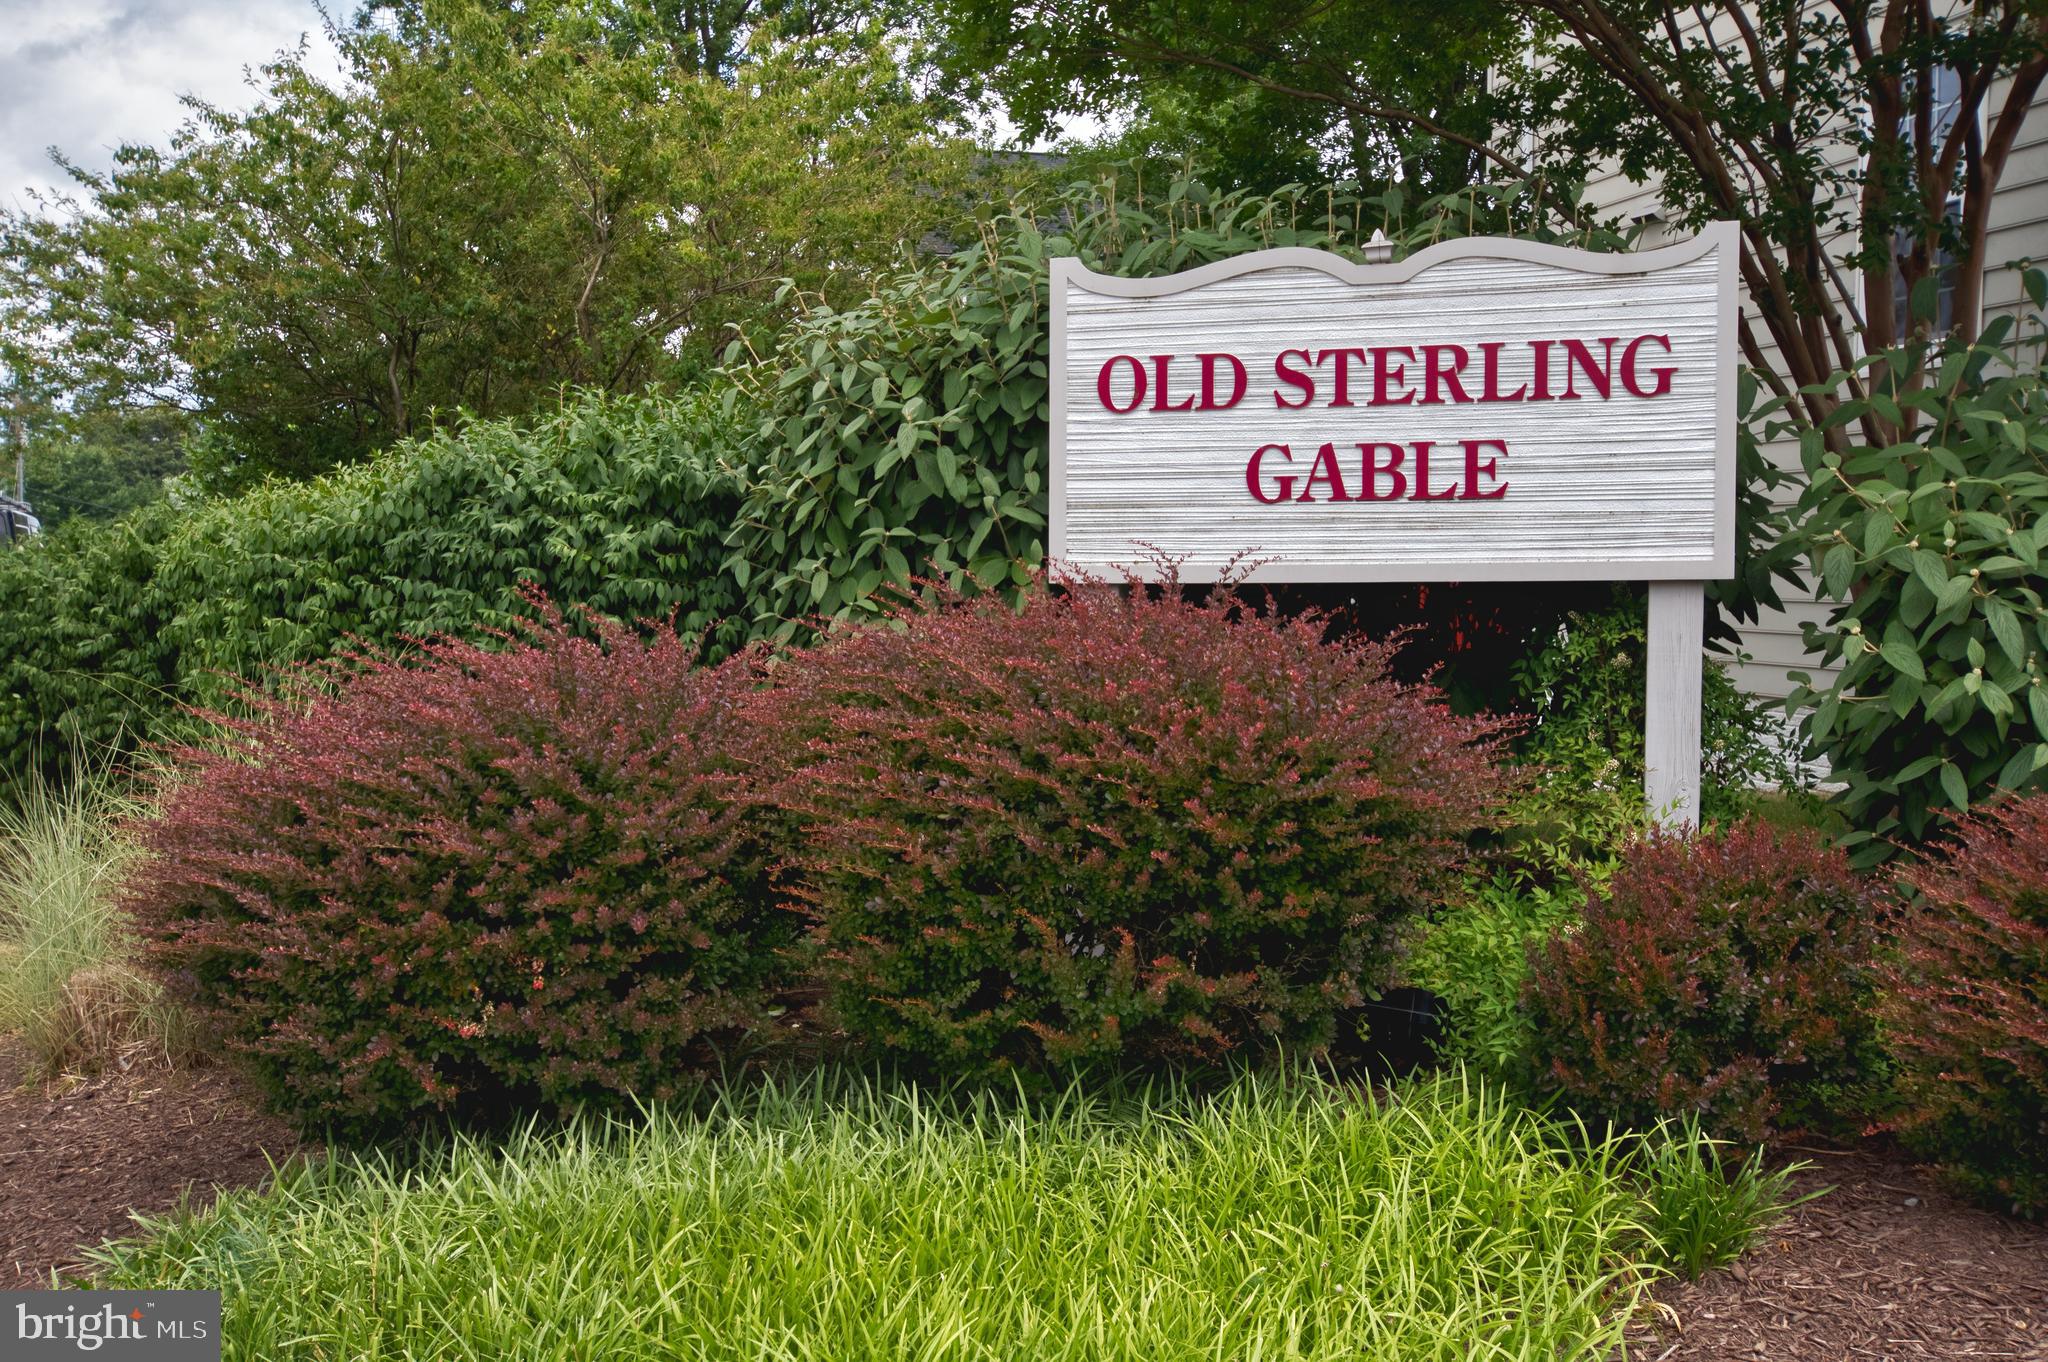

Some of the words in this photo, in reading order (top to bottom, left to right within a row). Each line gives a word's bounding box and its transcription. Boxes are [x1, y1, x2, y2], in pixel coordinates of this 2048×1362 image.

[1097, 352, 1249, 414] OLD
[1273, 334, 1679, 410] STERLING
[1245, 439, 1510, 505] GABLE
